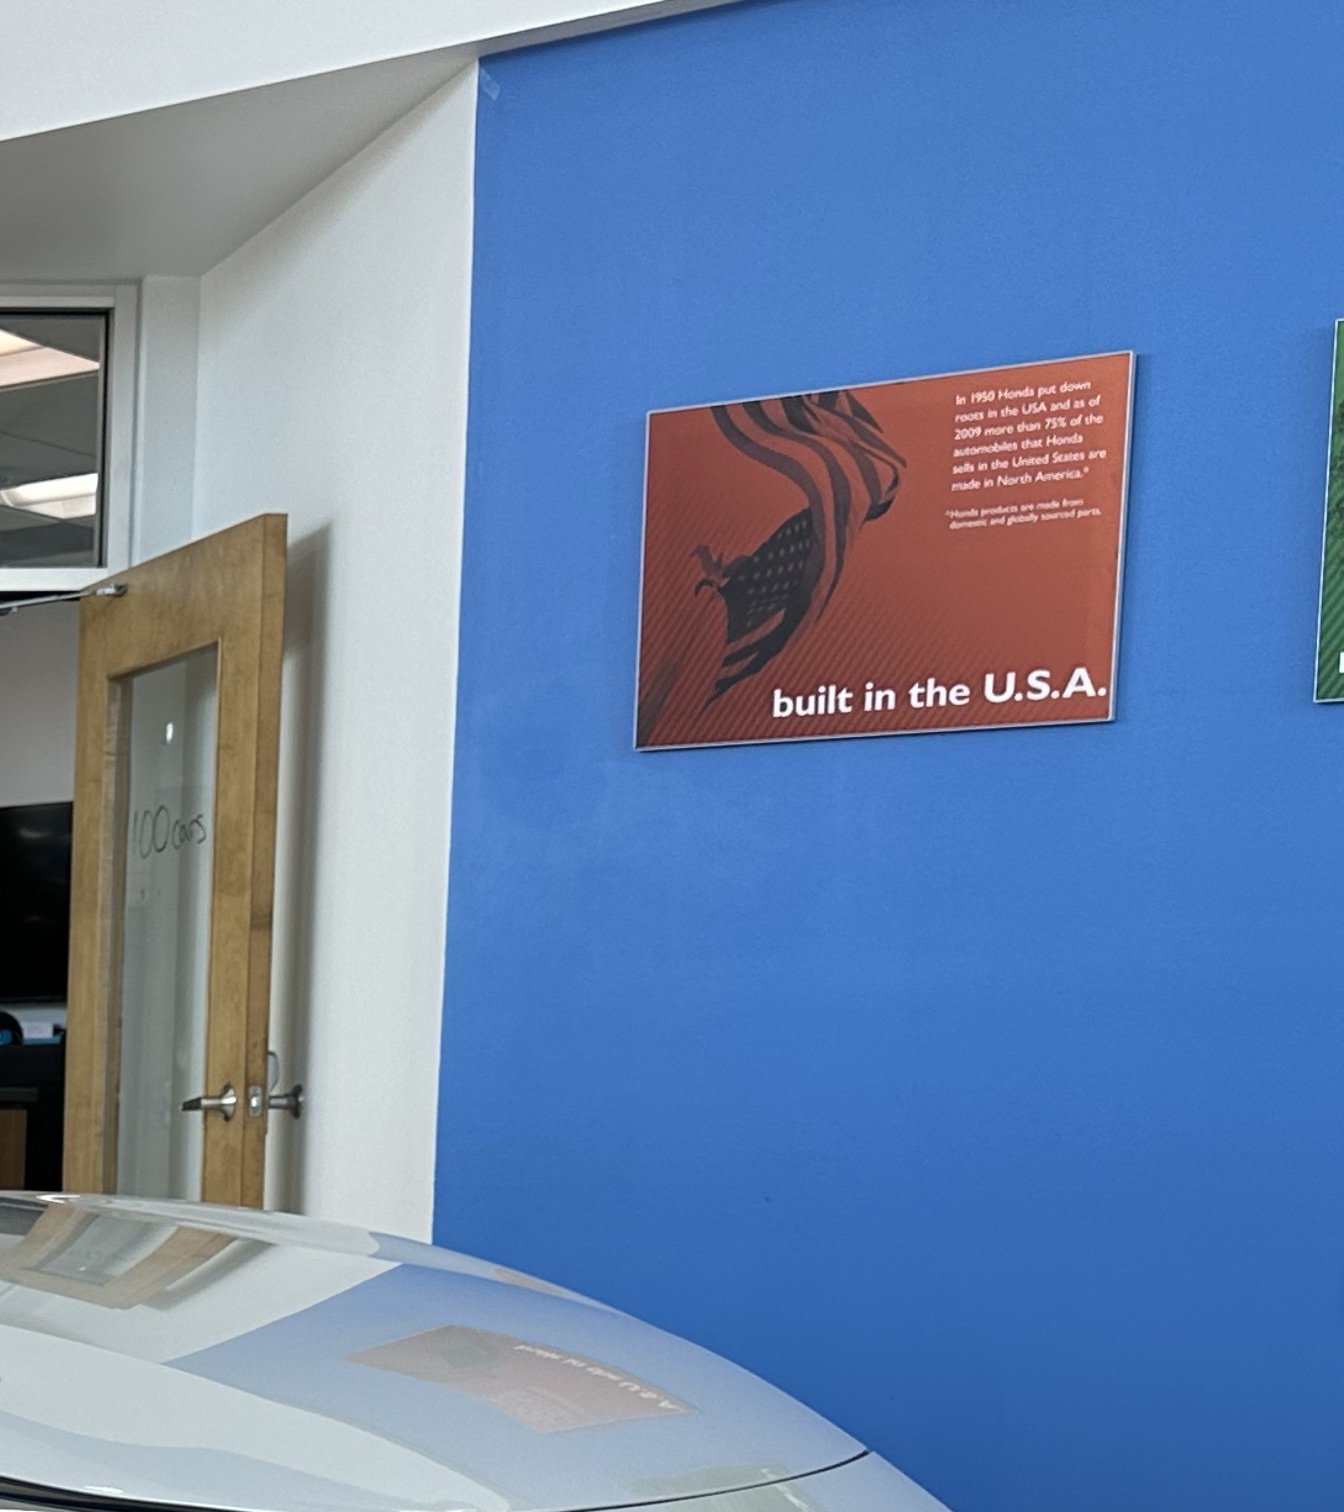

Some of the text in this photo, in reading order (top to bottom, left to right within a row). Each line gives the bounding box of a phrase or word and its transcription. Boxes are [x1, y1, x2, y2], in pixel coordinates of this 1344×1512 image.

[955, 394, 966, 406] In
[998, 387, 1034, 400] Honda
[1037, 384, 1056, 398] put
[1060, 380, 1092, 393] down
[955, 395, 1102, 423] roots in the USA and as of
[954, 414, 1104, 440] 2009 more than 75% of the
[953, 433, 1083, 458] automobiles that Honda
[952, 450, 1107, 474] sells in the United States are
[951, 478, 981, 492] made
[984, 477, 994, 487] in
[997, 472, 1032, 486] North
[772, 667, 1107, 718] built in the U.S.A.
